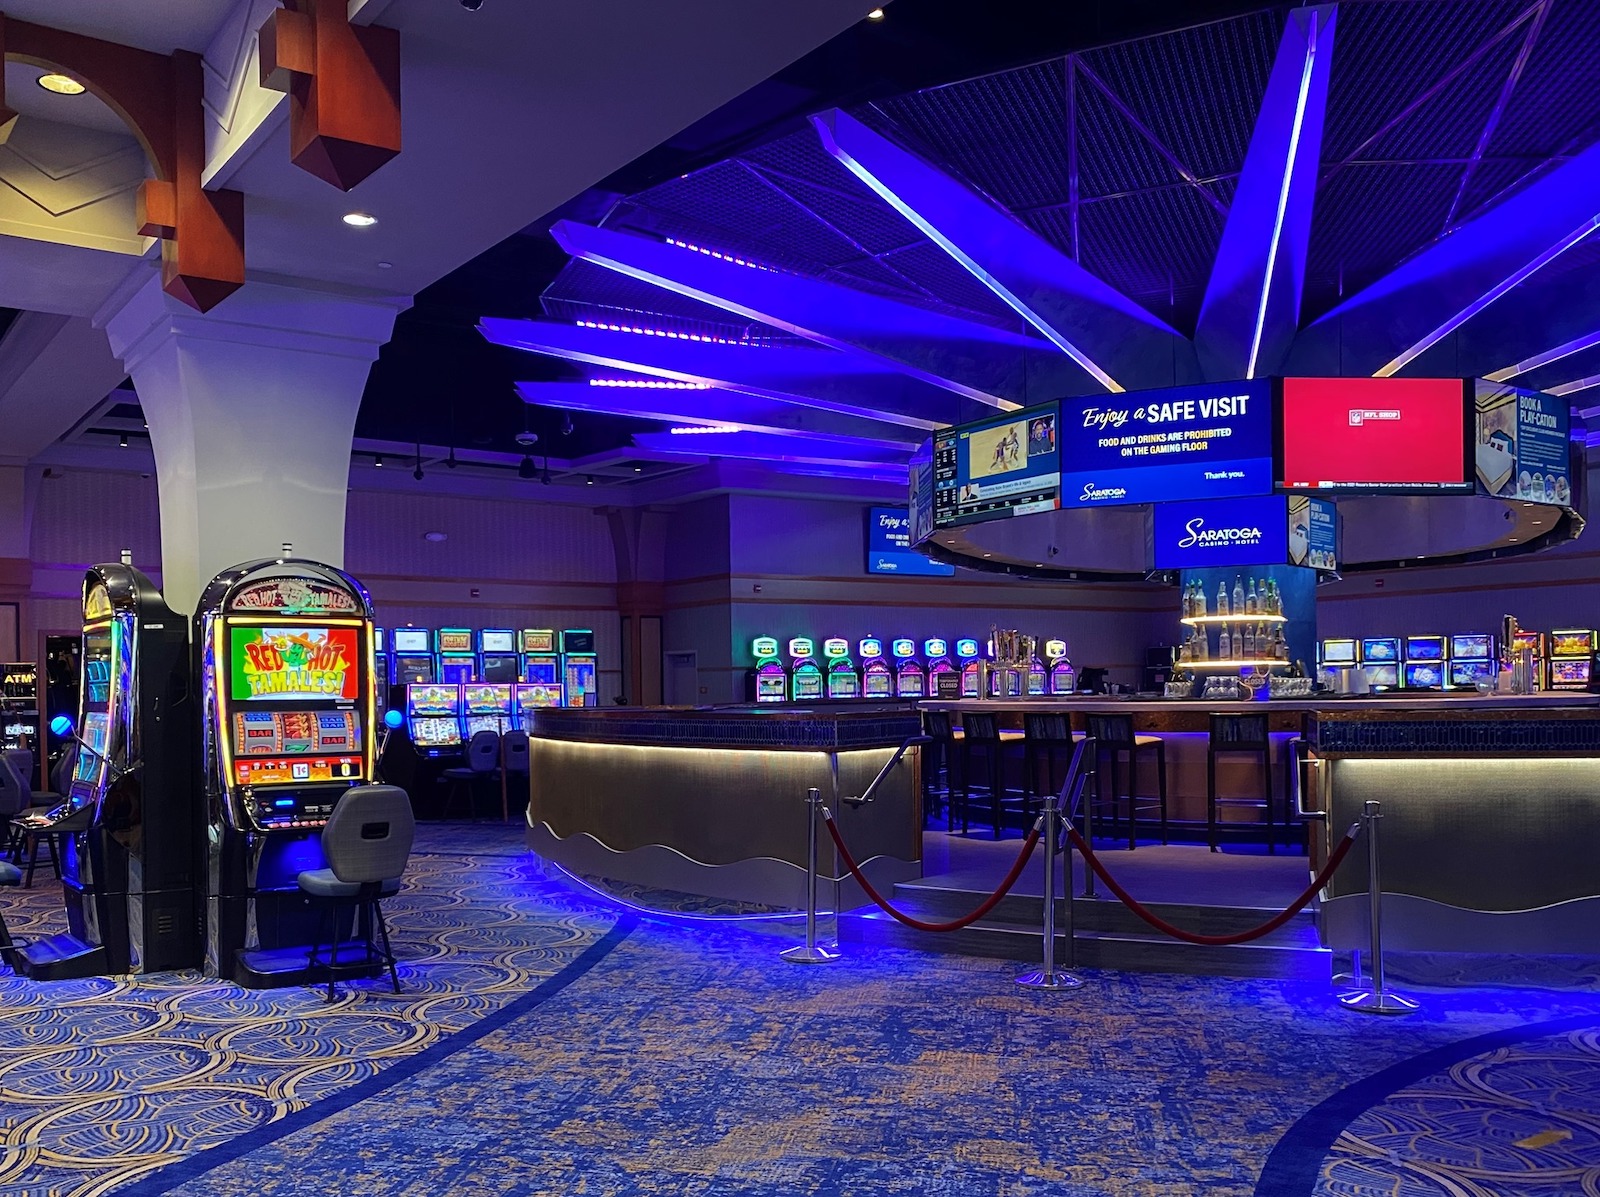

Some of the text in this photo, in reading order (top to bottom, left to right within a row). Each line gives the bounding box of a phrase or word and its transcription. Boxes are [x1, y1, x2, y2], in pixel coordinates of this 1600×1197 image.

[1520, 396, 1542, 412] BOOK A
[1082, 395, 1250, 431] Enjoy a SAFE VISIT
[1378, 411, 1398, 419] SHOP
[1520, 410, 1557, 429] PLAY-CATION
[1098, 427, 1232, 448] FOOD AND DRINKS ARE PROHIBITED
[1121, 441, 1208, 457] ON THE GAMING FLOOR
[1204, 471, 1245, 480] Thank you.
[1079, 483, 1126, 501] SARATOGA
[880, 515, 901, 529] Enjoy
[1178, 518, 1262, 548] SARATOGA
[245, 643, 346, 672] RED HOT
[4, 674, 33, 684] ATM
[249, 671, 344, 696] TAMALES!
[249, 729, 272, 737] BAR
[341, 763, 351, 777] 0
